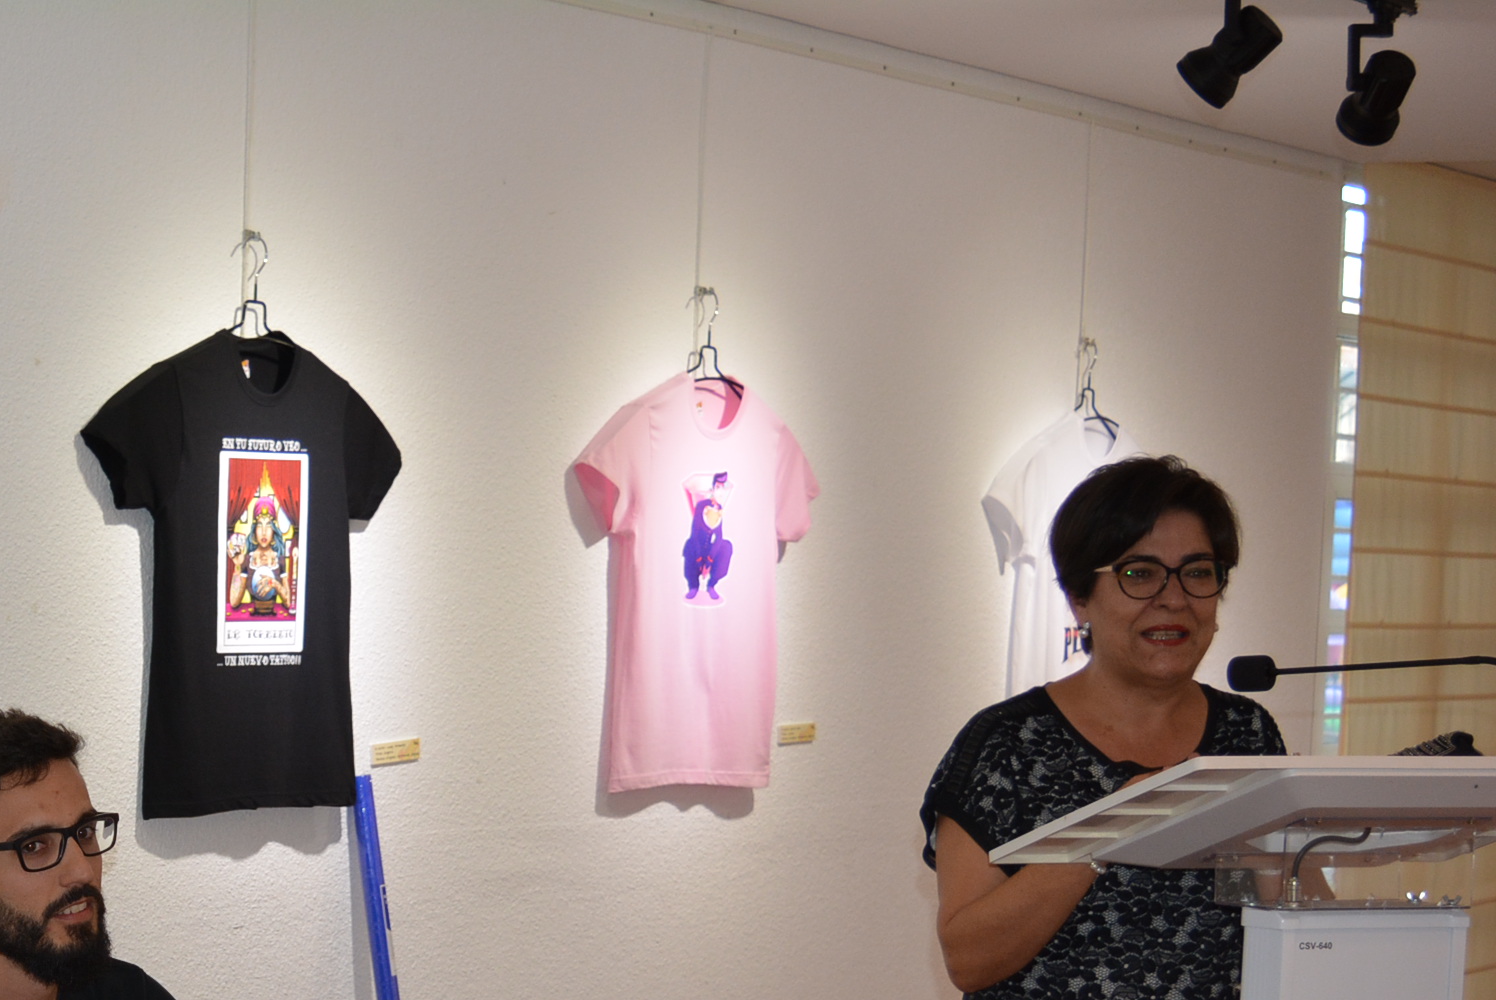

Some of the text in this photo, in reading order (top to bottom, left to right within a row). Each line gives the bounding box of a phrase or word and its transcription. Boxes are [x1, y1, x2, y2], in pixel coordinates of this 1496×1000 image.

[222, 437, 235, 449] EN
[236, 438, 248, 450] TU
[248, 439, 283, 452] FUTURO
[238, 655, 269, 666] NUEVO
[1299, 941, 1333, 950] CSV-640
